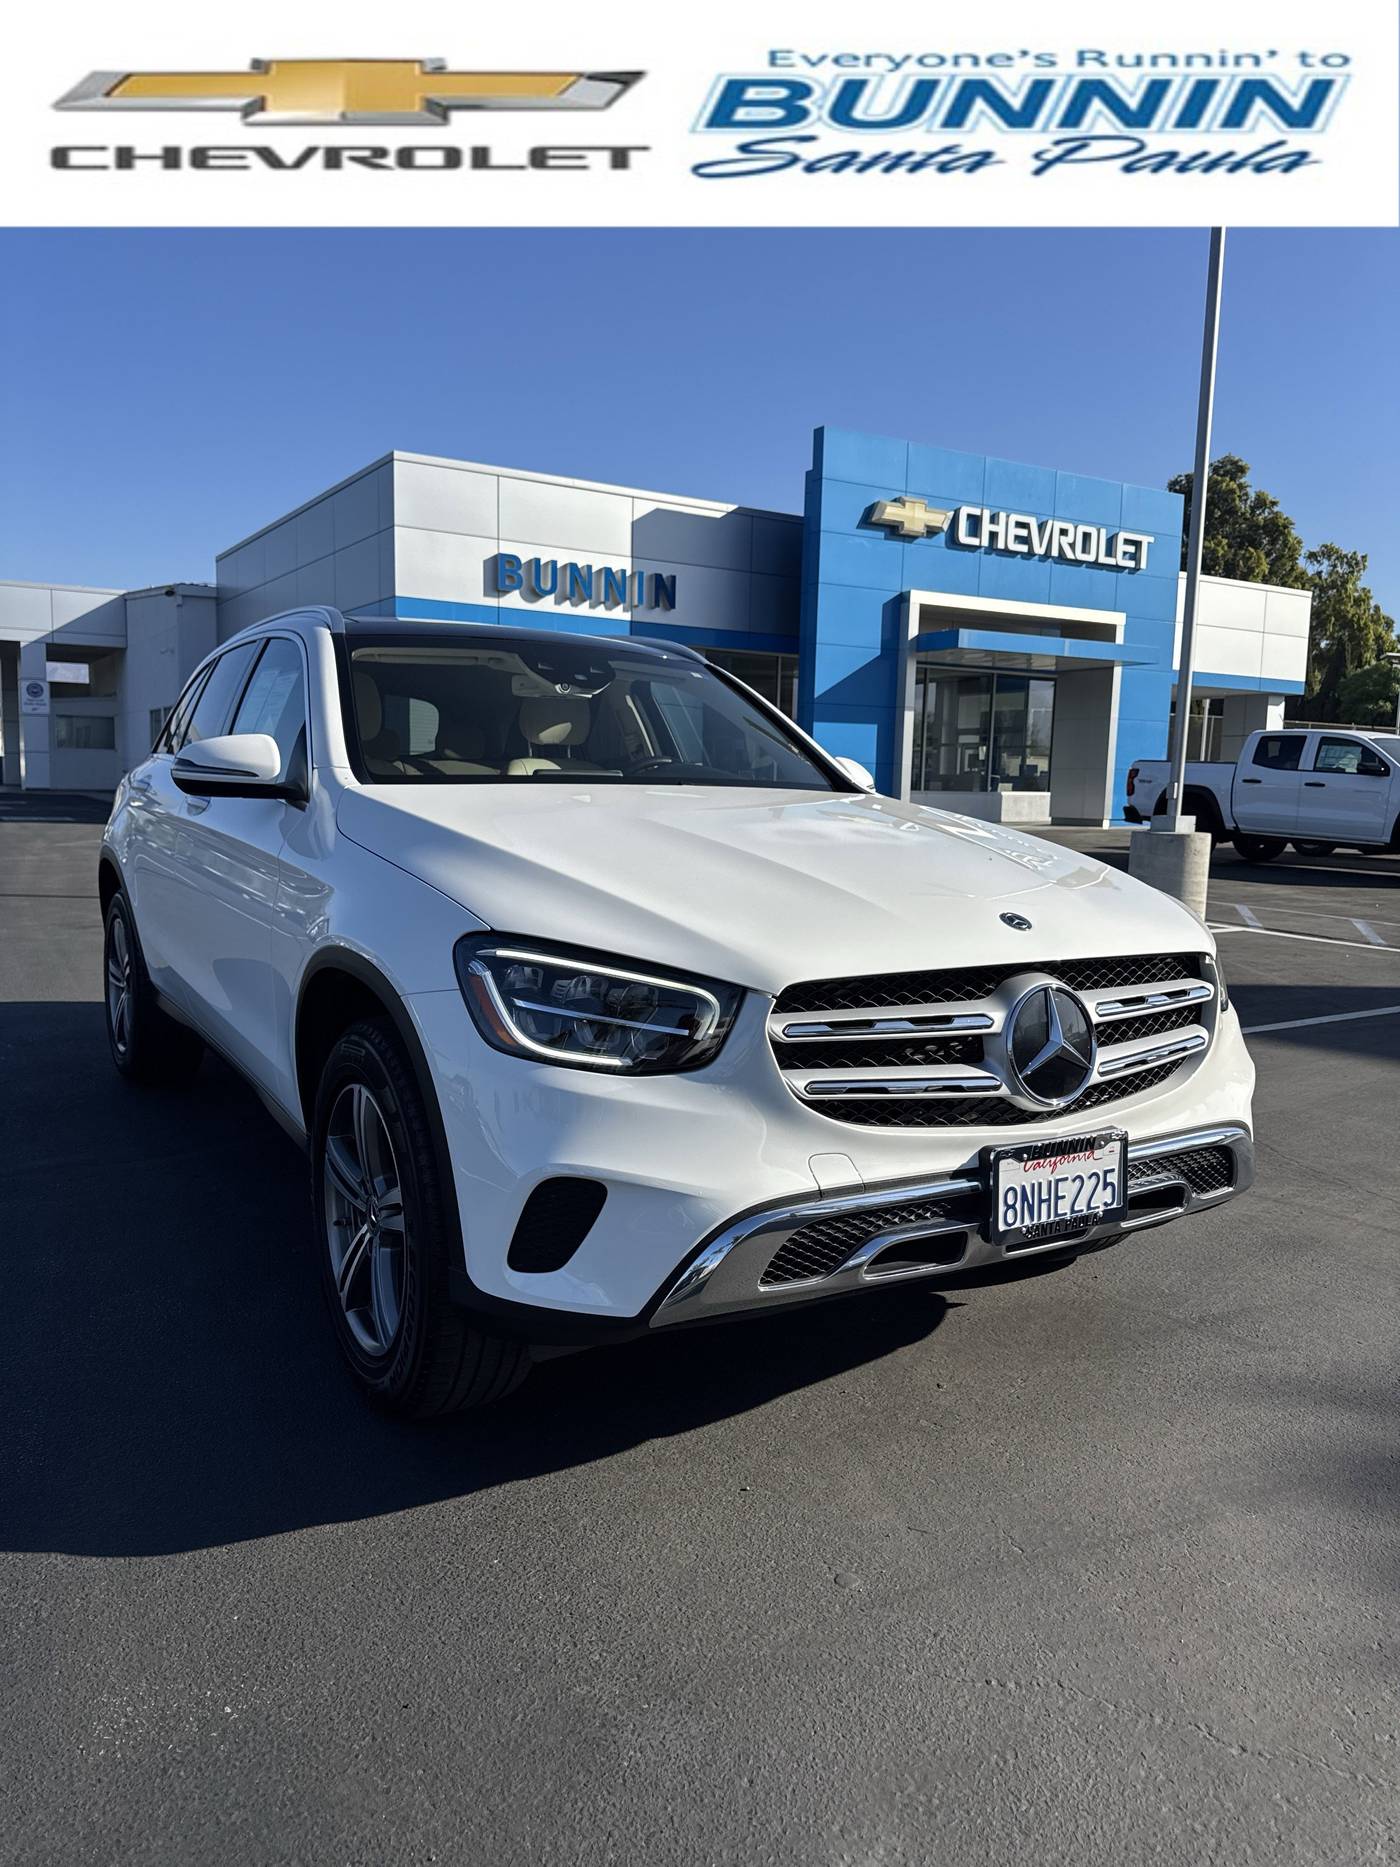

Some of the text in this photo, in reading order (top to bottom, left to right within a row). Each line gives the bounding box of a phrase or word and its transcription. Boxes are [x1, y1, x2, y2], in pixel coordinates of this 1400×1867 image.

[957, 504, 1156, 570] CHEVROLET
[495, 552, 677, 611] BUNNIN
[1030, 1135, 1098, 1161] BUNNIN
[1003, 1167, 1117, 1228] 8NHE225
[1064, 1211, 1101, 1232] PAULA
